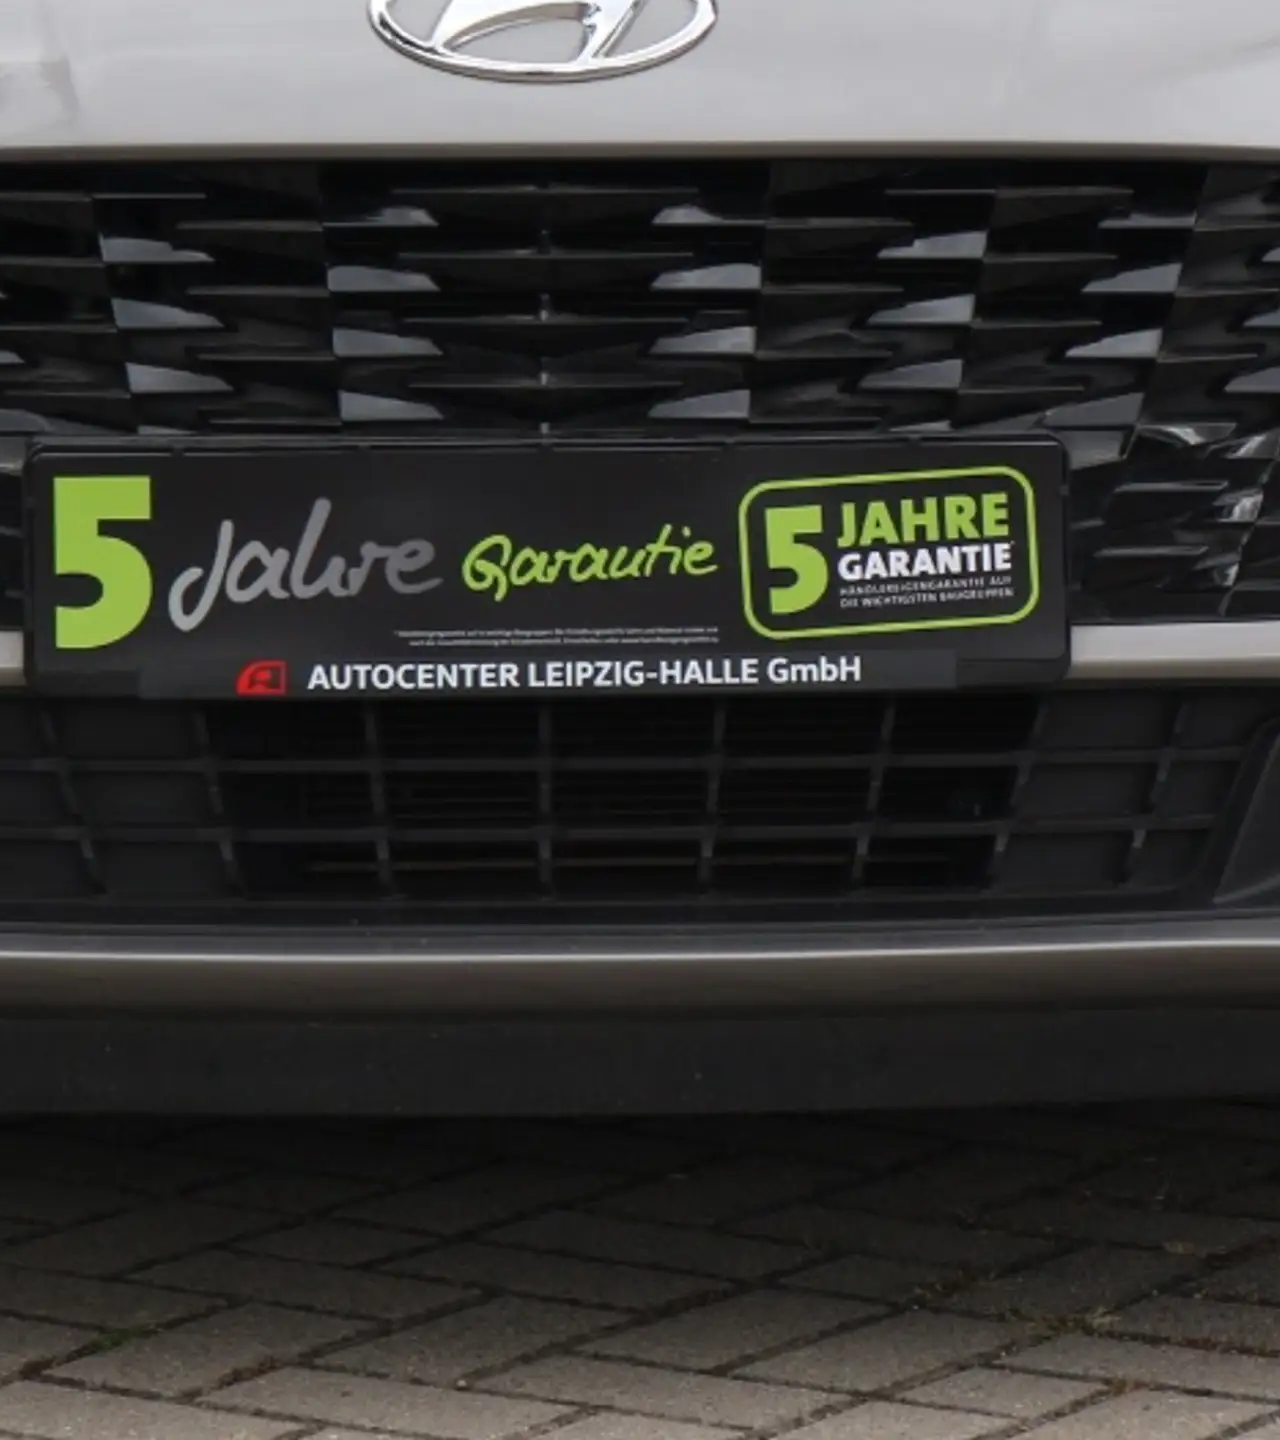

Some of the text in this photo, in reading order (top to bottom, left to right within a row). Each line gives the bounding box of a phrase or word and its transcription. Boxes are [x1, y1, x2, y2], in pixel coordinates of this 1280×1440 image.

[53, 475, 152, 648] 5
[765, 492, 1010, 614] 5 JAHRE
[838, 543, 1013, 581] GARANTIE
[307, 657, 862, 690] AUTOCENTER LEIPZIG-HALLE GmbH
